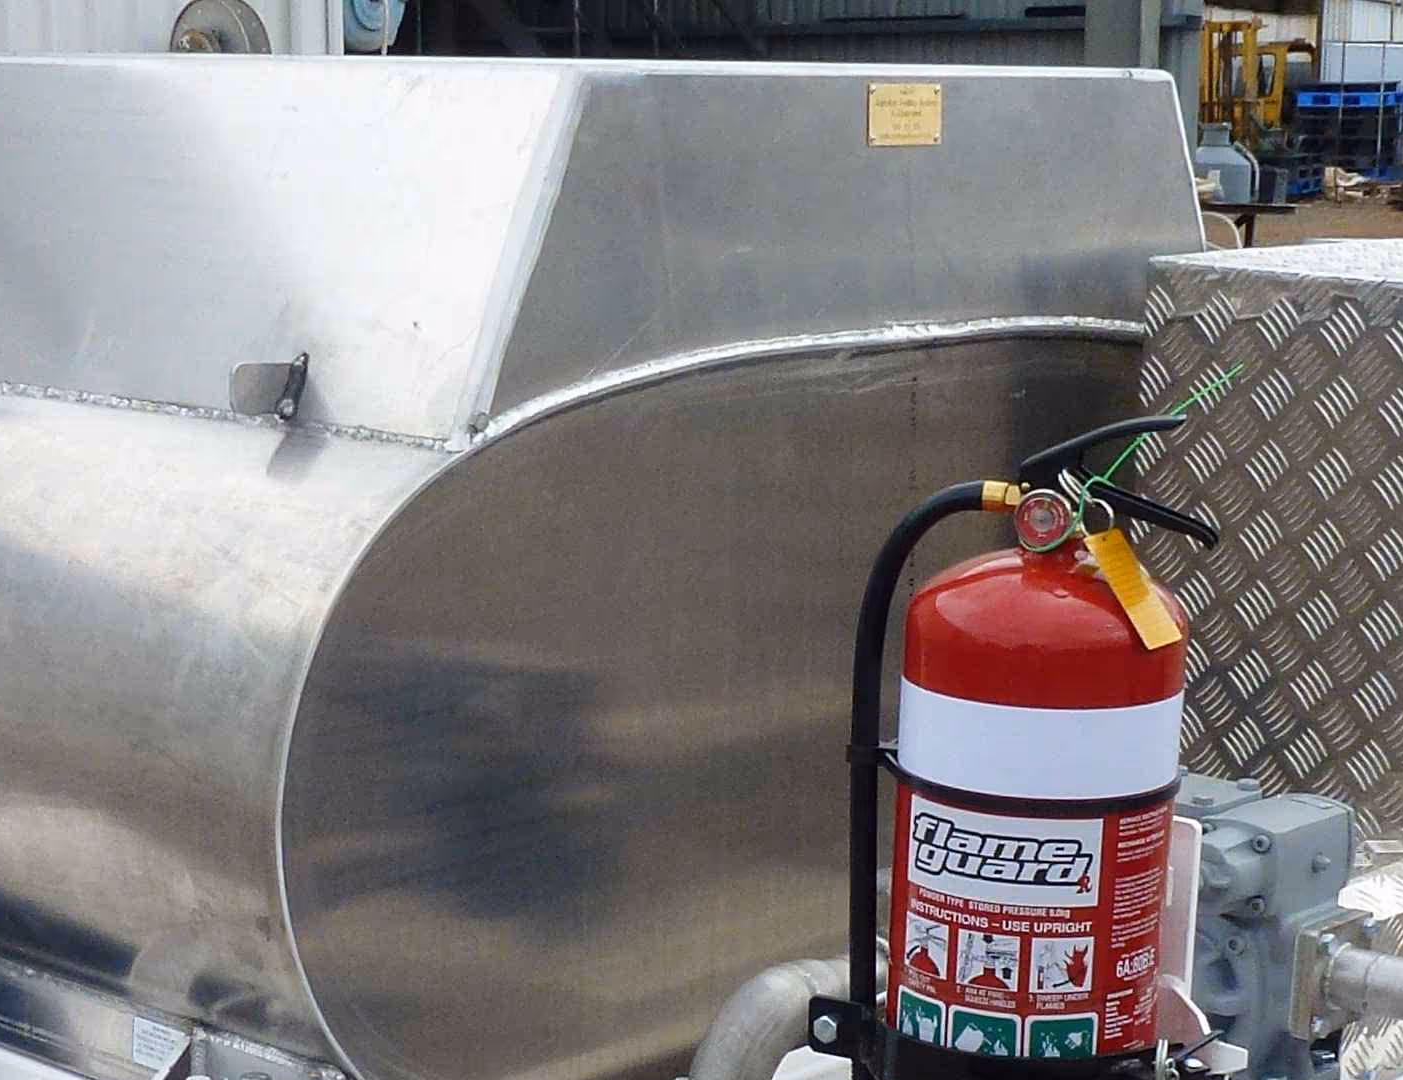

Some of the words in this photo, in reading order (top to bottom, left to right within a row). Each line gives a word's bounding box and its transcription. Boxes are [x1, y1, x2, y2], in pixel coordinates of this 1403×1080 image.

[913, 813, 1083, 864] flame
[914, 843, 1094, 887] guard
[911, 898, 989, 929] INSTRUCTIONS
[1002, 920, 1030, 933] USE
[1034, 921, 1093, 933] UPRIGHT
